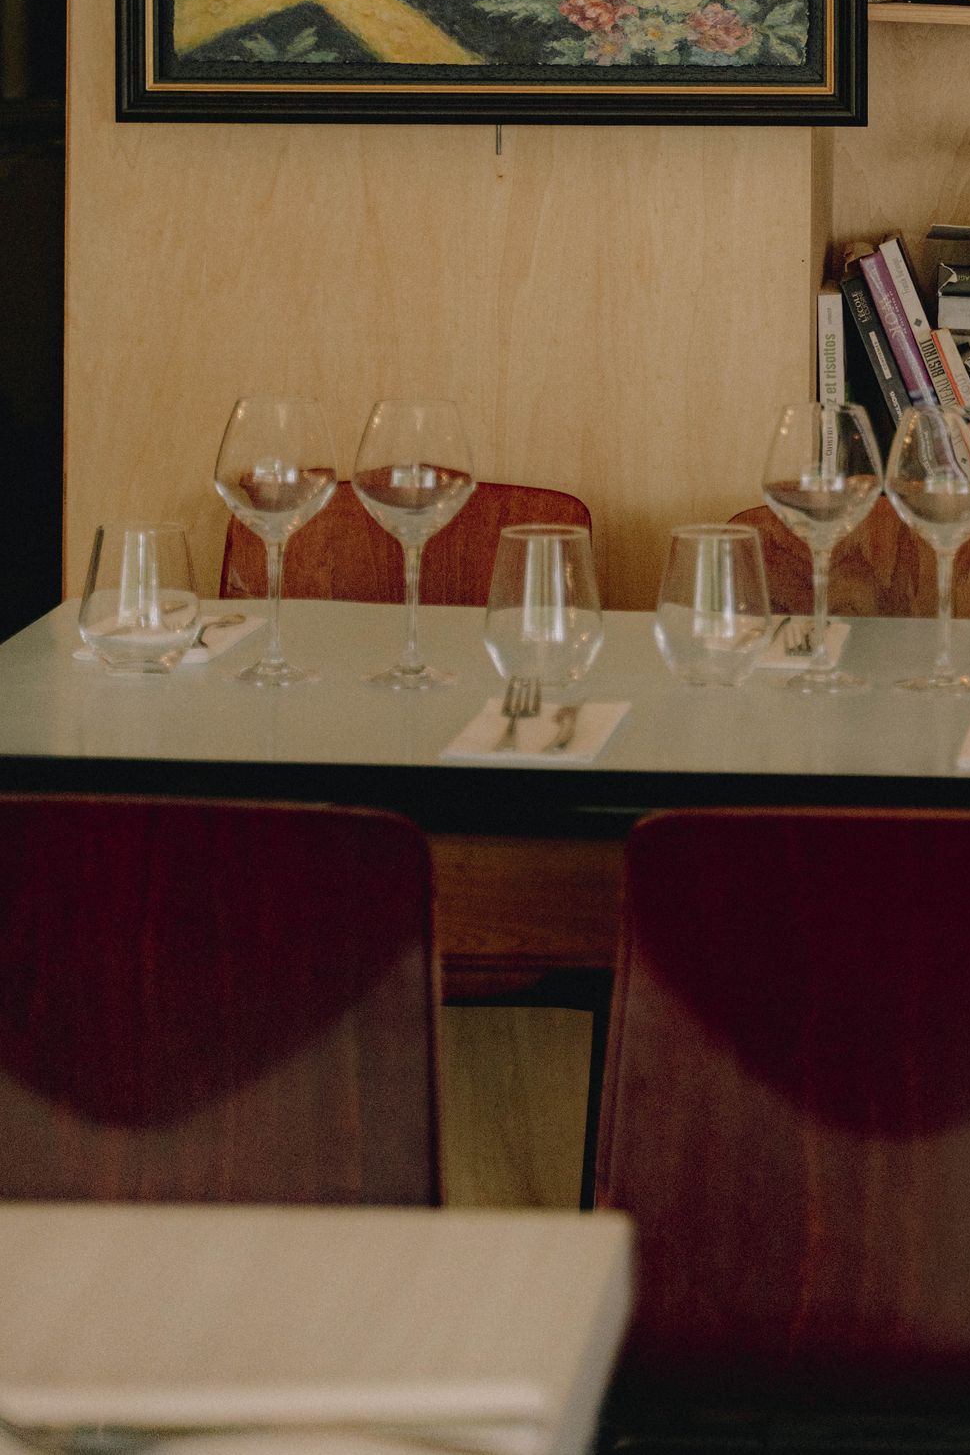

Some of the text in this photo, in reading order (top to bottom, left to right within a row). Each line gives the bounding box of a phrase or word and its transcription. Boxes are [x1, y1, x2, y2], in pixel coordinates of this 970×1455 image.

[822, 333, 836, 379] risottos
[918, 336, 945, 379] BISTROT
[824, 381, 836, 394] et
